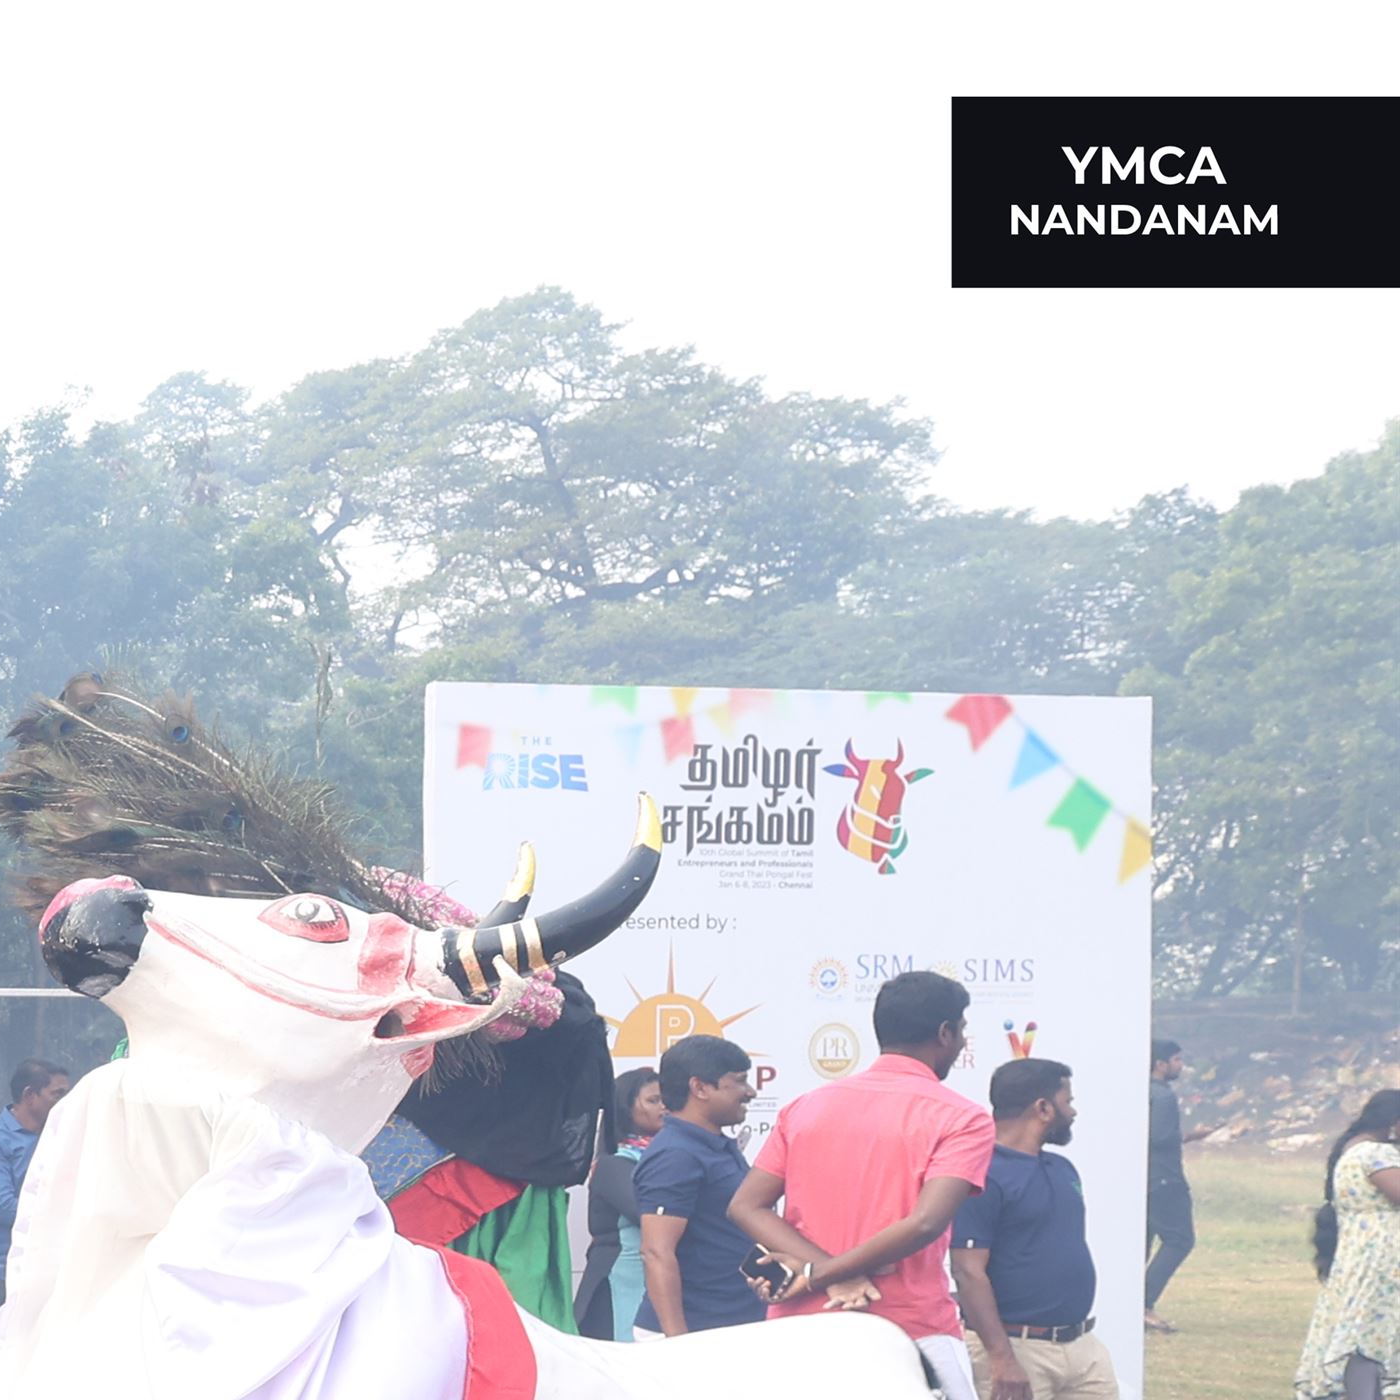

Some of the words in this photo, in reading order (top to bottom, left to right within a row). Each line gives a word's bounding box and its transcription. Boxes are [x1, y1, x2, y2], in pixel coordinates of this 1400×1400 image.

[520, 736, 552, 746] THE
[482, 752, 589, 792] RISE
[679, 733, 822, 807] தமிழர்
[662, 794, 816, 858] சங்கமம்
[625, 914, 699, 930] esented
[706, 914, 728, 933] by
[855, 953, 914, 980] SRM
[963, 958, 1035, 983] SIMS
[823, 1037, 848, 1057] PR
